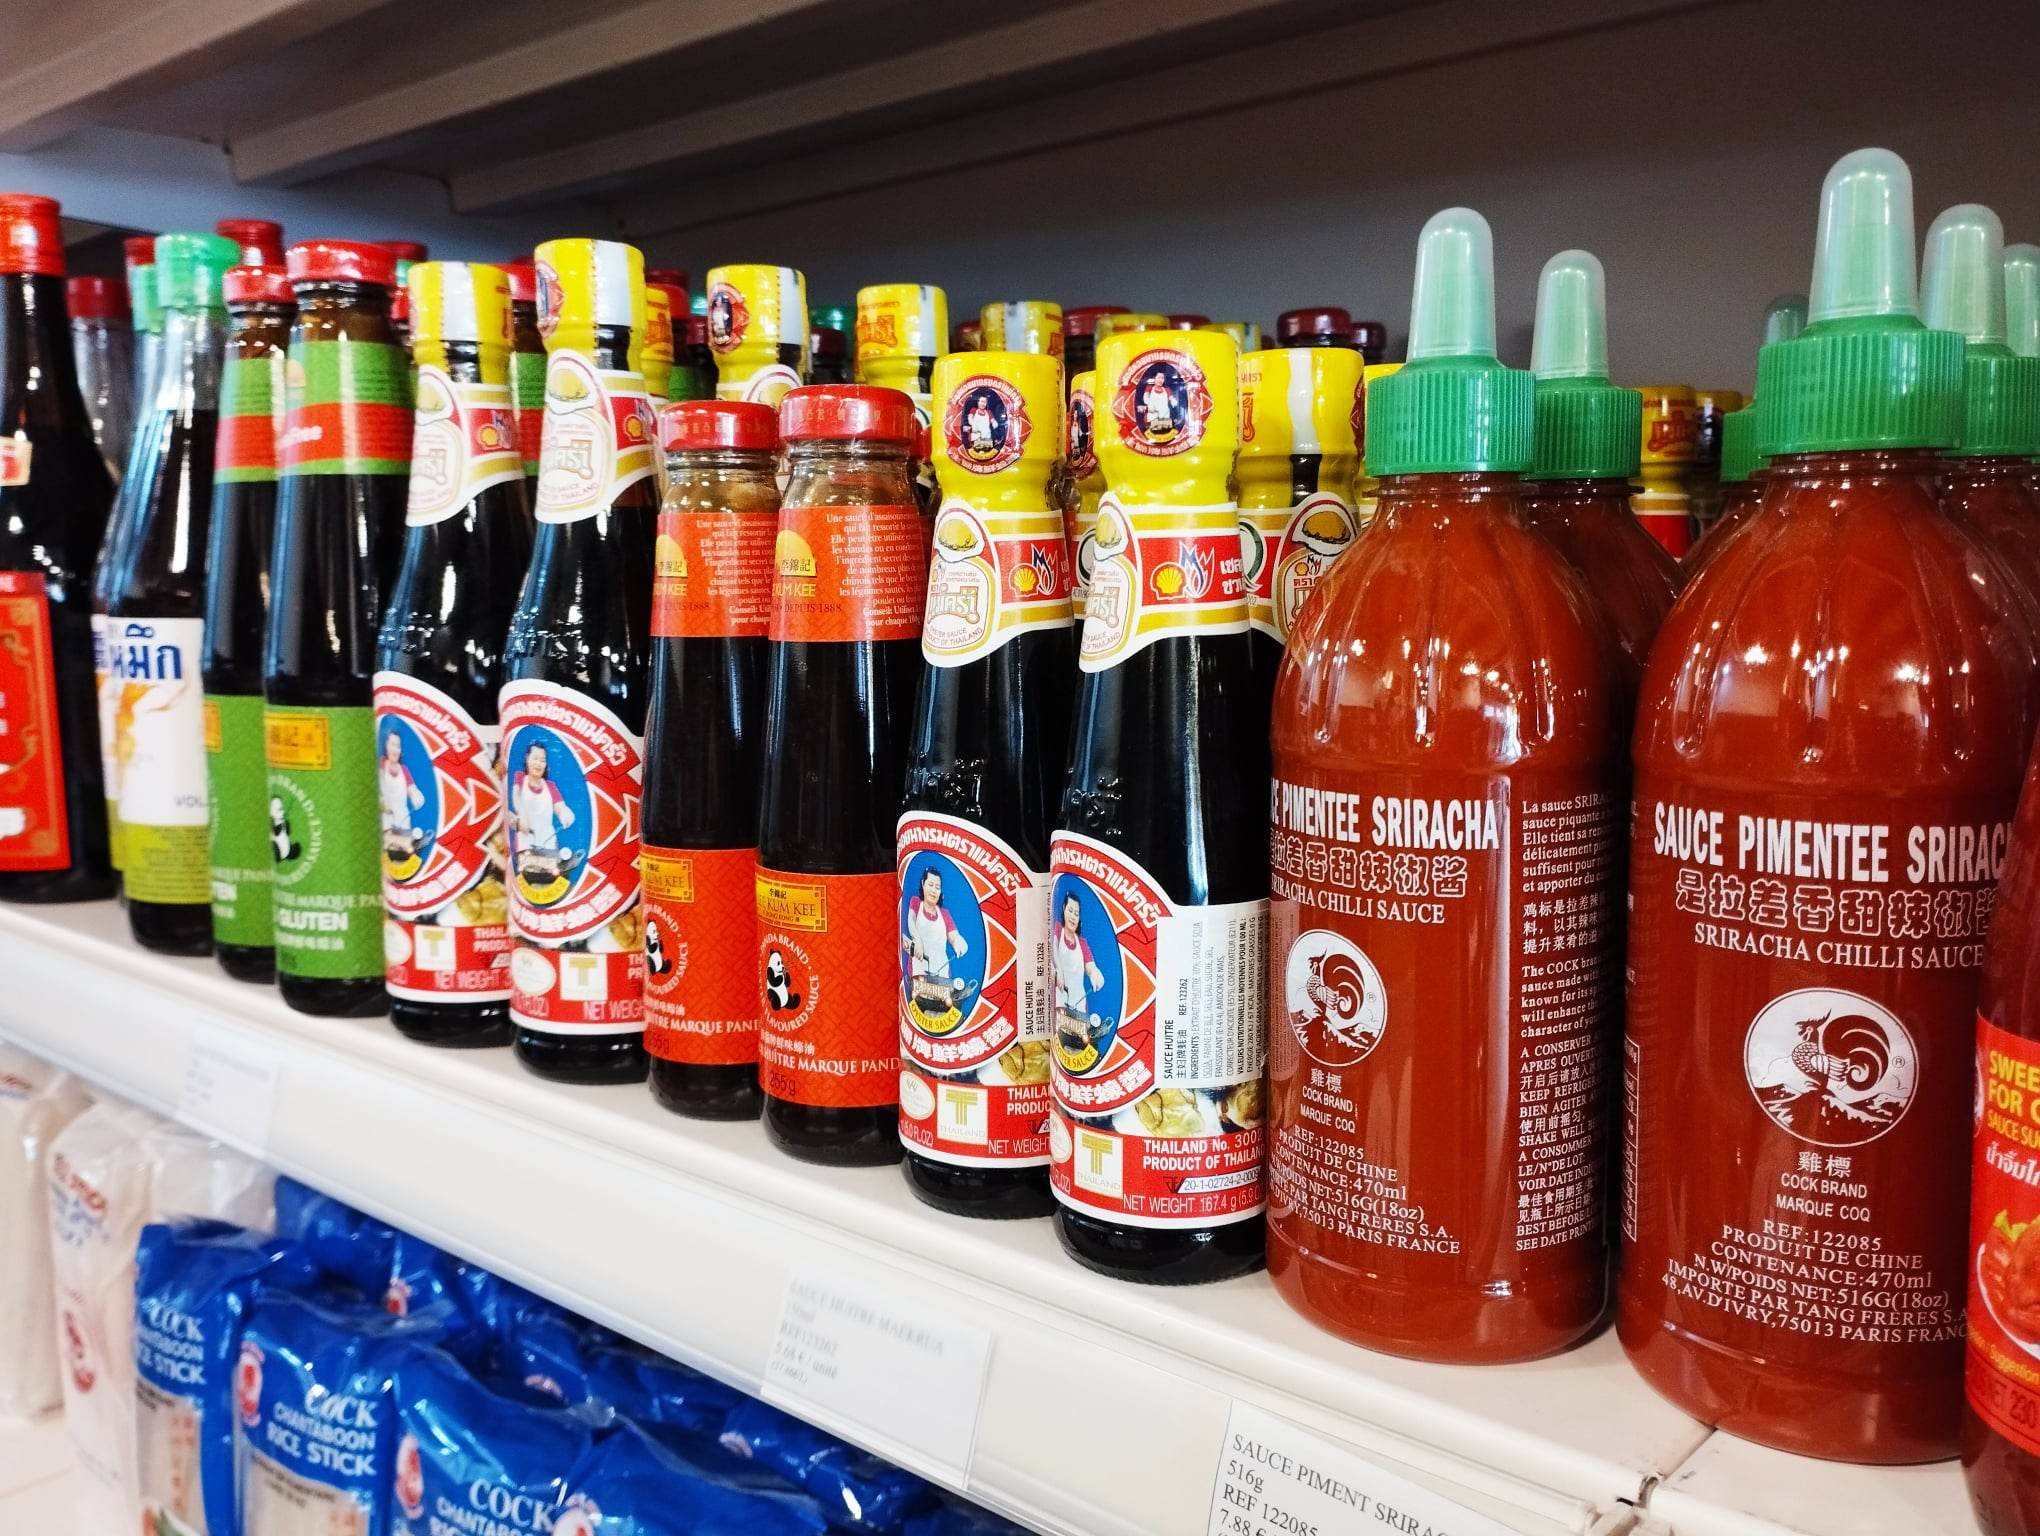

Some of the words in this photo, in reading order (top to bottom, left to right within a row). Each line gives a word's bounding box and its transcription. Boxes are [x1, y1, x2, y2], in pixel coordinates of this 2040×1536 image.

[794, 583, 816, 597] KEE
[819, 604, 842, 613] 1888
[1282, 782, 1361, 843] PIMENTEE
[1371, 795, 1500, 850] SRIRACHA
[1523, 801, 1539, 814] La
[1542, 800, 1573, 813] sauce
[1523, 817, 1556, 829] sauce
[1559, 812, 1599, 830] piquante
[1523, 832, 1547, 845] Elle
[1550, 830, 1575, 843] tient
[1577, 830, 1587, 839] sa
[1654, 801, 1724, 866] SAUCE
[1738, 814, 1889, 883] PIMENTEE
[1523, 843, 1592, 861] délicatement
[1523, 862, 1573, 877] suffisent
[1523, 881, 1534, 892] et
[1538, 876, 1582, 893] apporter
[793, 903, 817, 916] KEE
[1318, 890, 1373, 918] CHILLI
[1377, 899, 1445, 924] SAUCE
[779, 934, 809, 965] BRAND
[1694, 921, 1811, 961] SRIRACHA
[1816, 941, 1905, 969] CHILLI
[1911, 944, 1984, 969] SAUCE
[1522, 966, 1544, 977] The
[1547, 959, 1579, 974] COCK
[806, 975, 819, 1013] SAUCE
[1521, 981, 1554, 993] sauce
[1556, 975, 1581, 988] made
[1521, 994, 1559, 1008] known
[1562, 991, 1576, 1002] for
[1521, 1008, 1545, 1022] will
[1547, 1004, 1586, 1020] enhance
[670, 1020, 723, 1035] MARQUE
[1026, 1010, 1034, 1035] SAUCE
[1165, 1019, 1173, 1050] HUITRE
[1521, 1022, 1572, 1038] character
[1520, 1048, 1529, 1058] A
[1534, 1035, 1591, 1056] CONSERVER
[798, 1058, 857, 1076] MARQUE
[1164, 1052, 1173, 1079] SAUCE
[1520, 1058, 1556, 1073] APRES
[1302, 1086, 1322, 1105] COCK
[1324, 1094, 1353, 1113] BRAND
[1520, 1089, 1550, 1103] KEEP
[1520, 1104, 1548, 1118] BIEN
[1552, 1096, 1586, 1114] AGITER
[1988, 1078, 2023, 1116] FOR
[1300, 1104, 1332, 1126] MARQUE
[1335, 1117, 1355, 1134] COQ
[1988, 1109, 2019, 1141] SAUCE
[988, 1139, 1009, 1154] NET
[1144, 1139, 1207, 1155] THAILAND
[1212, 1138, 1230, 1151] No.
[1294, 1124, 1364, 1160] REF:122085
[1518, 1151, 1527, 1162] A
[1532, 1135, 1592, 1160] CONSOMMER
[1519, 1131, 1557, 1147] SHAKE
[1561, 1124, 1585, 1139] WELL
[1143, 1155, 1201, 1171] PRODUCT
[1206, 1155, 1220, 1168] OF
[1279, 1129, 1321, 1161] PRODUIT
[1324, 1152, 1343, 1169] DE
[1345, 1159, 1398, 1182] CHINE
[1275, 1142, 1407, 1200] CONTENANCE:470ml
[1518, 1177, 1547, 1192] VOIR
[1549, 1172, 1573, 1186] DATE
[1781, 1172, 1818, 1193] COCK
[1821, 1178, 1868, 1199] BRAND
[1123, 1194, 1145, 1212] NET
[1150, 1196, 1193, 1214] WEIGHT
[1290, 1183, 1309, 1206] PAR
[1310, 1195, 1348, 1220] TANG
[1351, 1210, 1415, 1235] FRERES
[1419, 1223, 1453, 1239] S.A.
[1776, 1194, 1833, 1218] MARQUE
[1839, 1204, 1871, 1223] COQ
[1337, 1220, 1383, 1244] PARIS
[1386, 1233, 1460, 1254] FRANCE
[1516, 1221, 1547, 1237] BEST
[1516, 1238, 1538, 1251] SEE
[1540, 1231, 1568, 1247] DATE
[1763, 1219, 1881, 1251] REF:122085
[1722, 1225, 1816, 1259] PRODUIT
[1820, 1248, 1850, 1265] DE
[1856, 1254, 1923, 1269] CHINE
[1711, 1241, 1932, 1289] CONTENANCE:470ml
[1669, 1258, 1746, 1300] IMPORTE
[1751, 1289, 1789, 1312] PAR
[1795, 1299, 1855, 1323] TANG
[1861, 1310, 1938, 1326] FRERES
[1694, 1253, 1787, 1294] N.W/POIDS
[1791, 1281, 1949, 1312] NET:516G(18oz)
[1840, 1325, 1901, 1342] PARIS
[305, 1393, 378, 1428] COCK
[306, 1442, 376, 1477] STICK
[1232, 1433, 1293, 1477] SAUCE
[1297, 1463, 1371, 1513] PIMENT
[1228, 1460, 1264, 1494] 516g
[469, 1478, 557, 1532] COCK
[1223, 1483, 1258, 1512] REF
